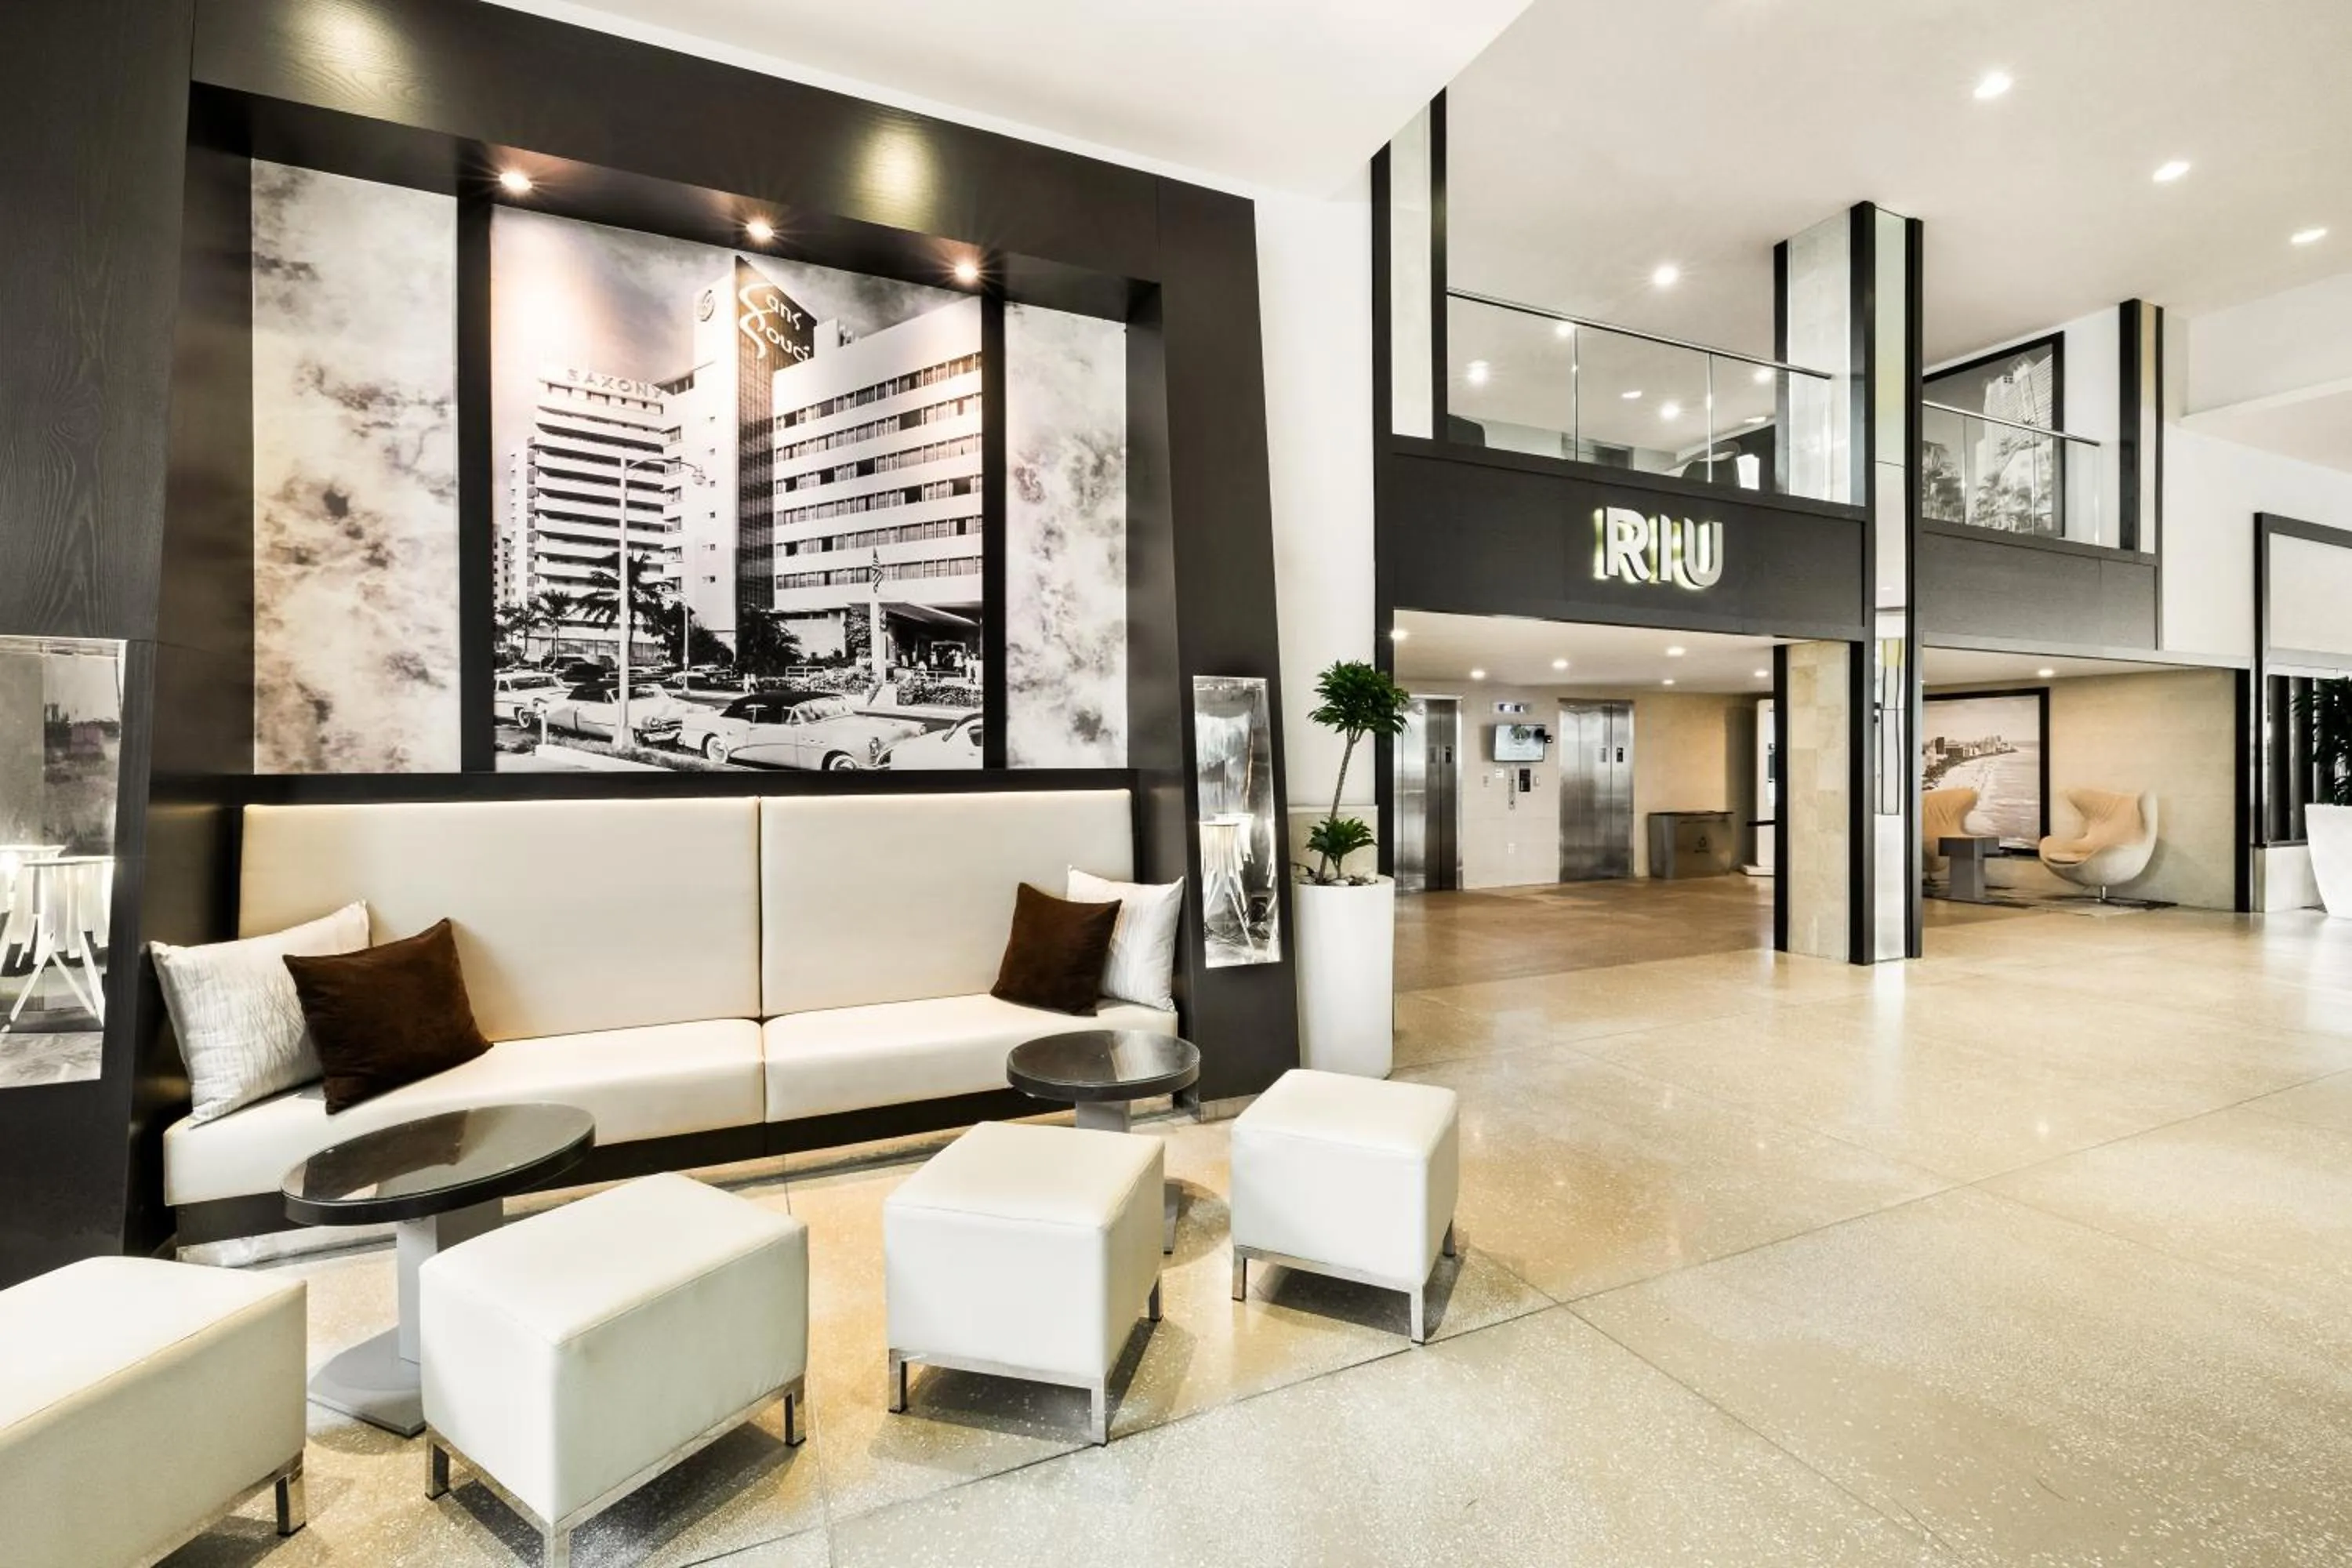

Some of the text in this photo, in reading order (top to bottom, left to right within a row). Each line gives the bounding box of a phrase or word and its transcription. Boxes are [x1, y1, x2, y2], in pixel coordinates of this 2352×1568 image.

[739, 283, 801, 331] Sans
[567, 368, 662, 398] SAXONY
[1605, 506, 1723, 587] RIU
